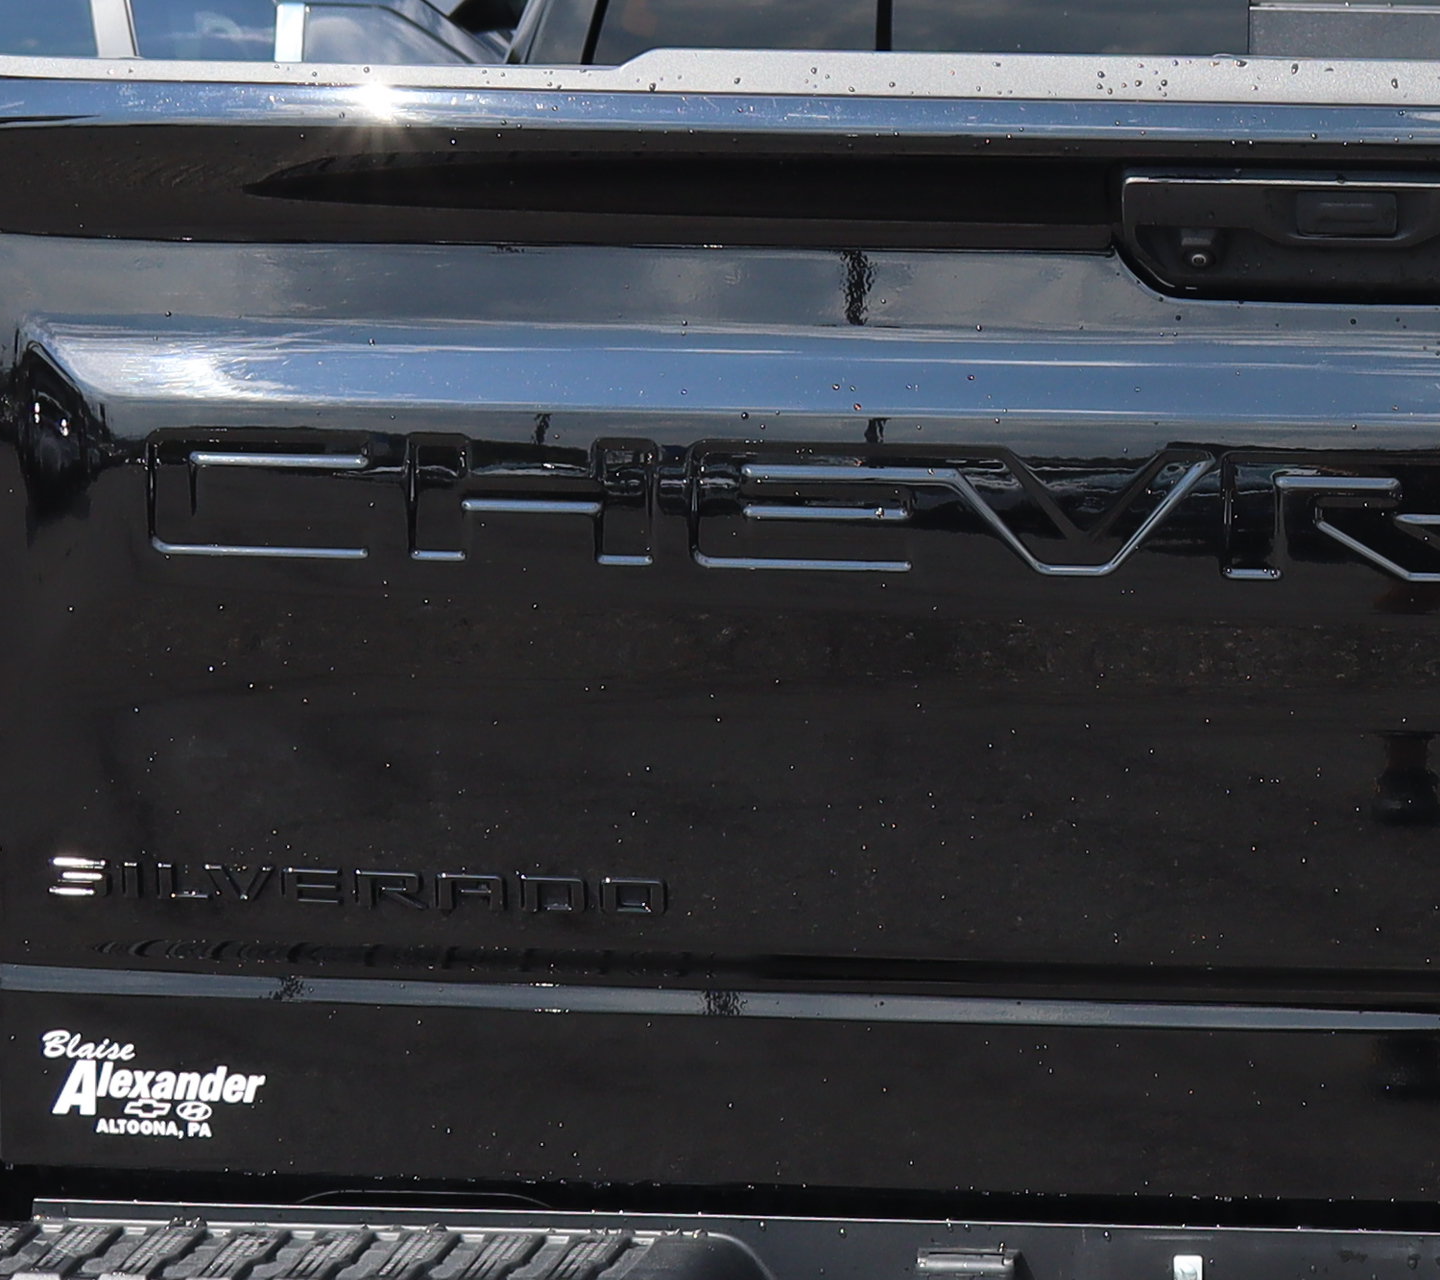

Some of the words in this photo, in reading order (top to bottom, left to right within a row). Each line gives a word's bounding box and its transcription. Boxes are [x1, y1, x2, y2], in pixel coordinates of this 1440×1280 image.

[48, 856, 668, 915] SILVERADO
[42, 1029, 136, 1061] Blaise
[52, 1059, 266, 1116] Alexander
[96, 1118, 184, 1139] ALTOONA,
[187, 1122, 212, 1137] PA
